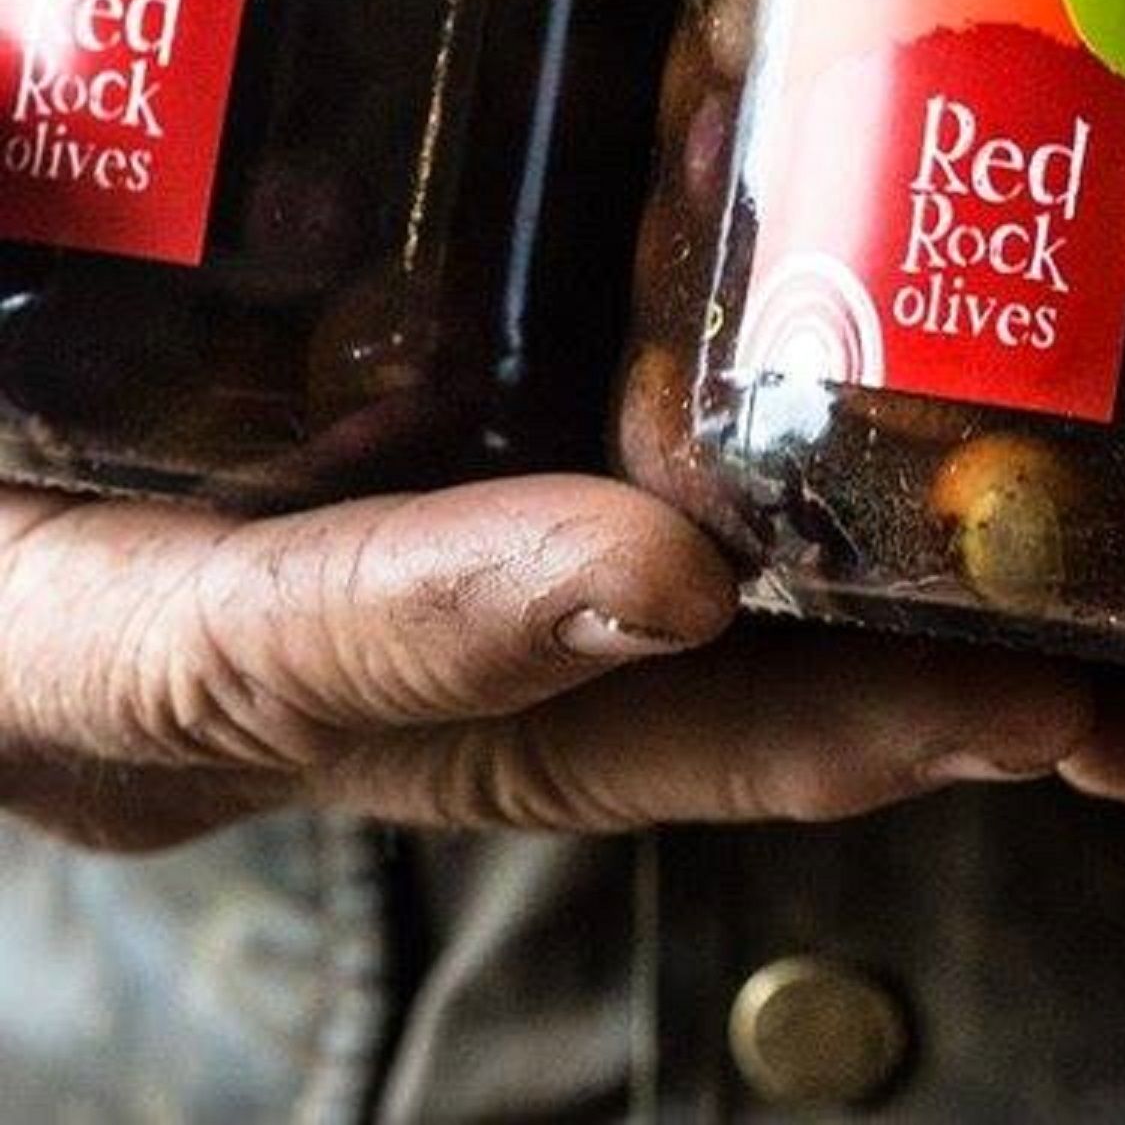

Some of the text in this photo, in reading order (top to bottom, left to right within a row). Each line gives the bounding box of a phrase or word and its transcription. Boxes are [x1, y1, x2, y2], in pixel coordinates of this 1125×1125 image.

[12, 42, 165, 139] Rock
[4, 120, 154, 192] olives
[910, 93, 1092, 221] Red
[902, 191, 1070, 294] Rock
[892, 274, 1058, 350] olives
